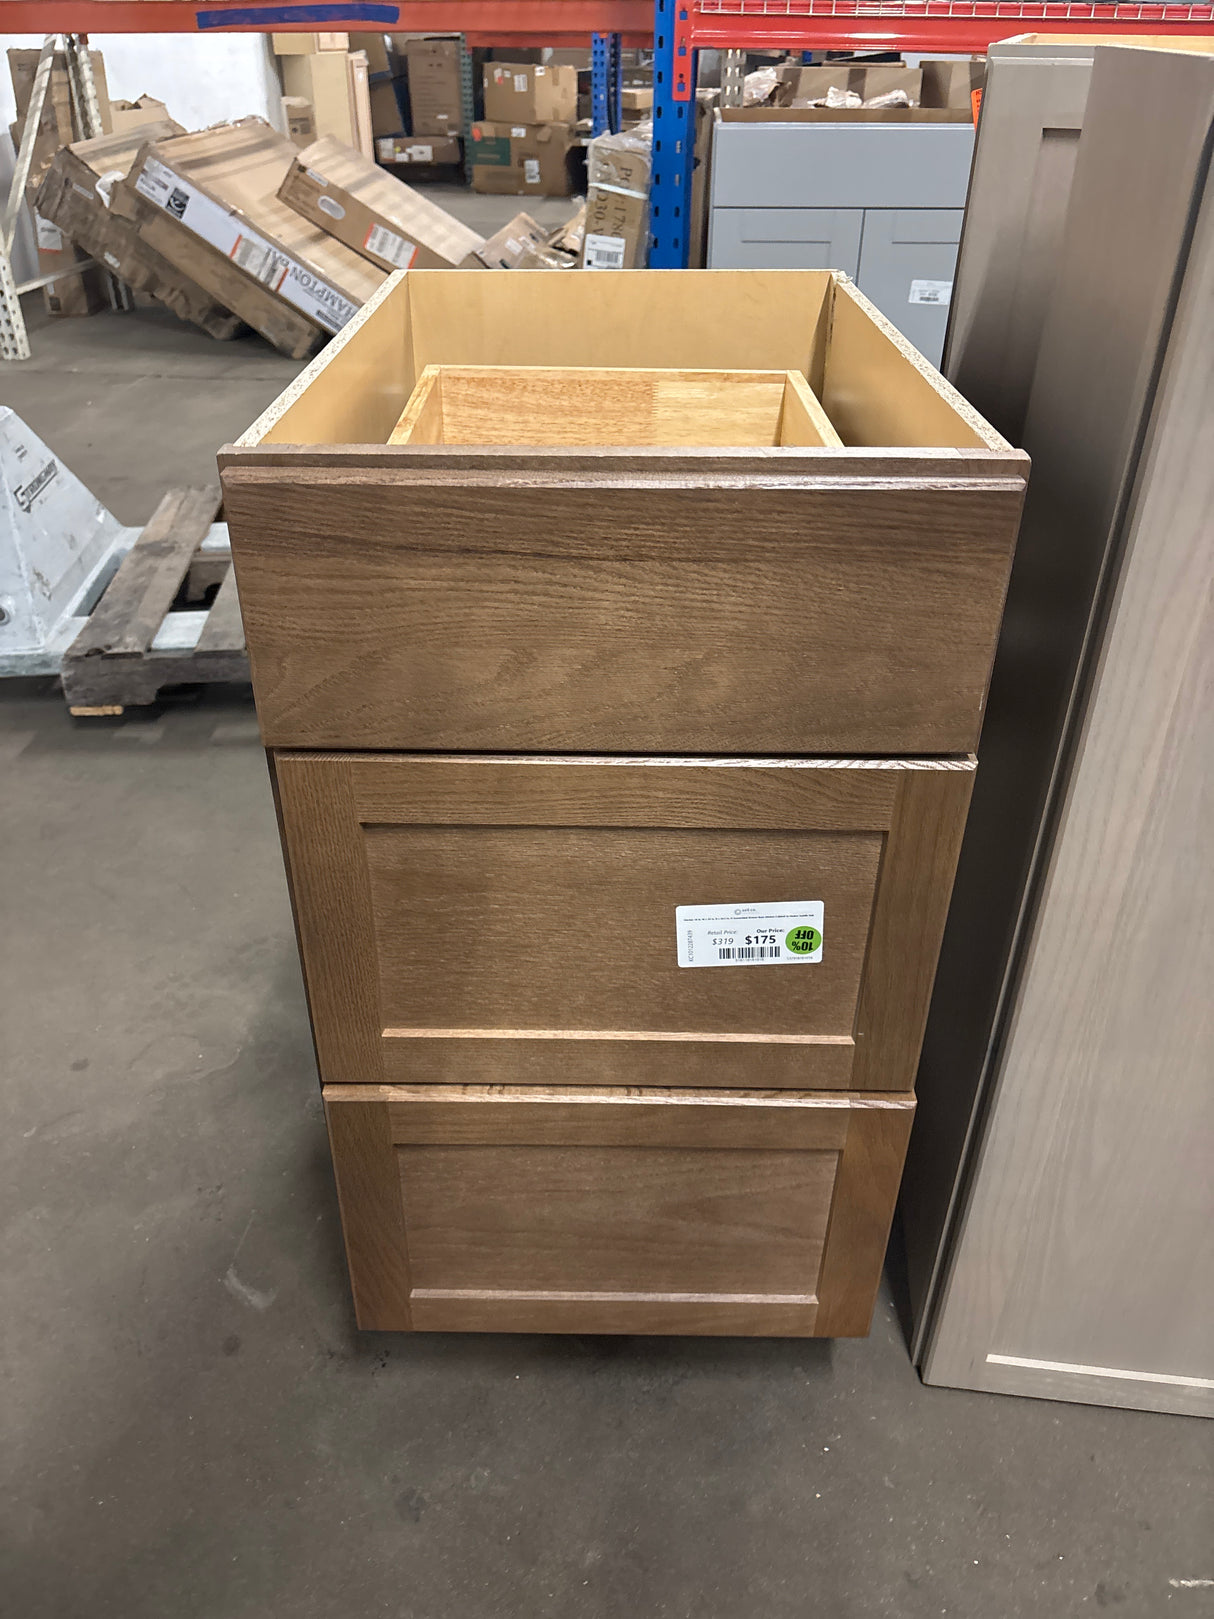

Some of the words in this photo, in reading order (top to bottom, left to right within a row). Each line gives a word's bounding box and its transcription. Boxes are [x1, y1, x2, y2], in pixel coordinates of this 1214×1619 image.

[794, 929, 814, 940] OFF
[712, 937, 734, 946] $319
[745, 935, 776, 945] $175
[791, 941, 814, 951] 10%
